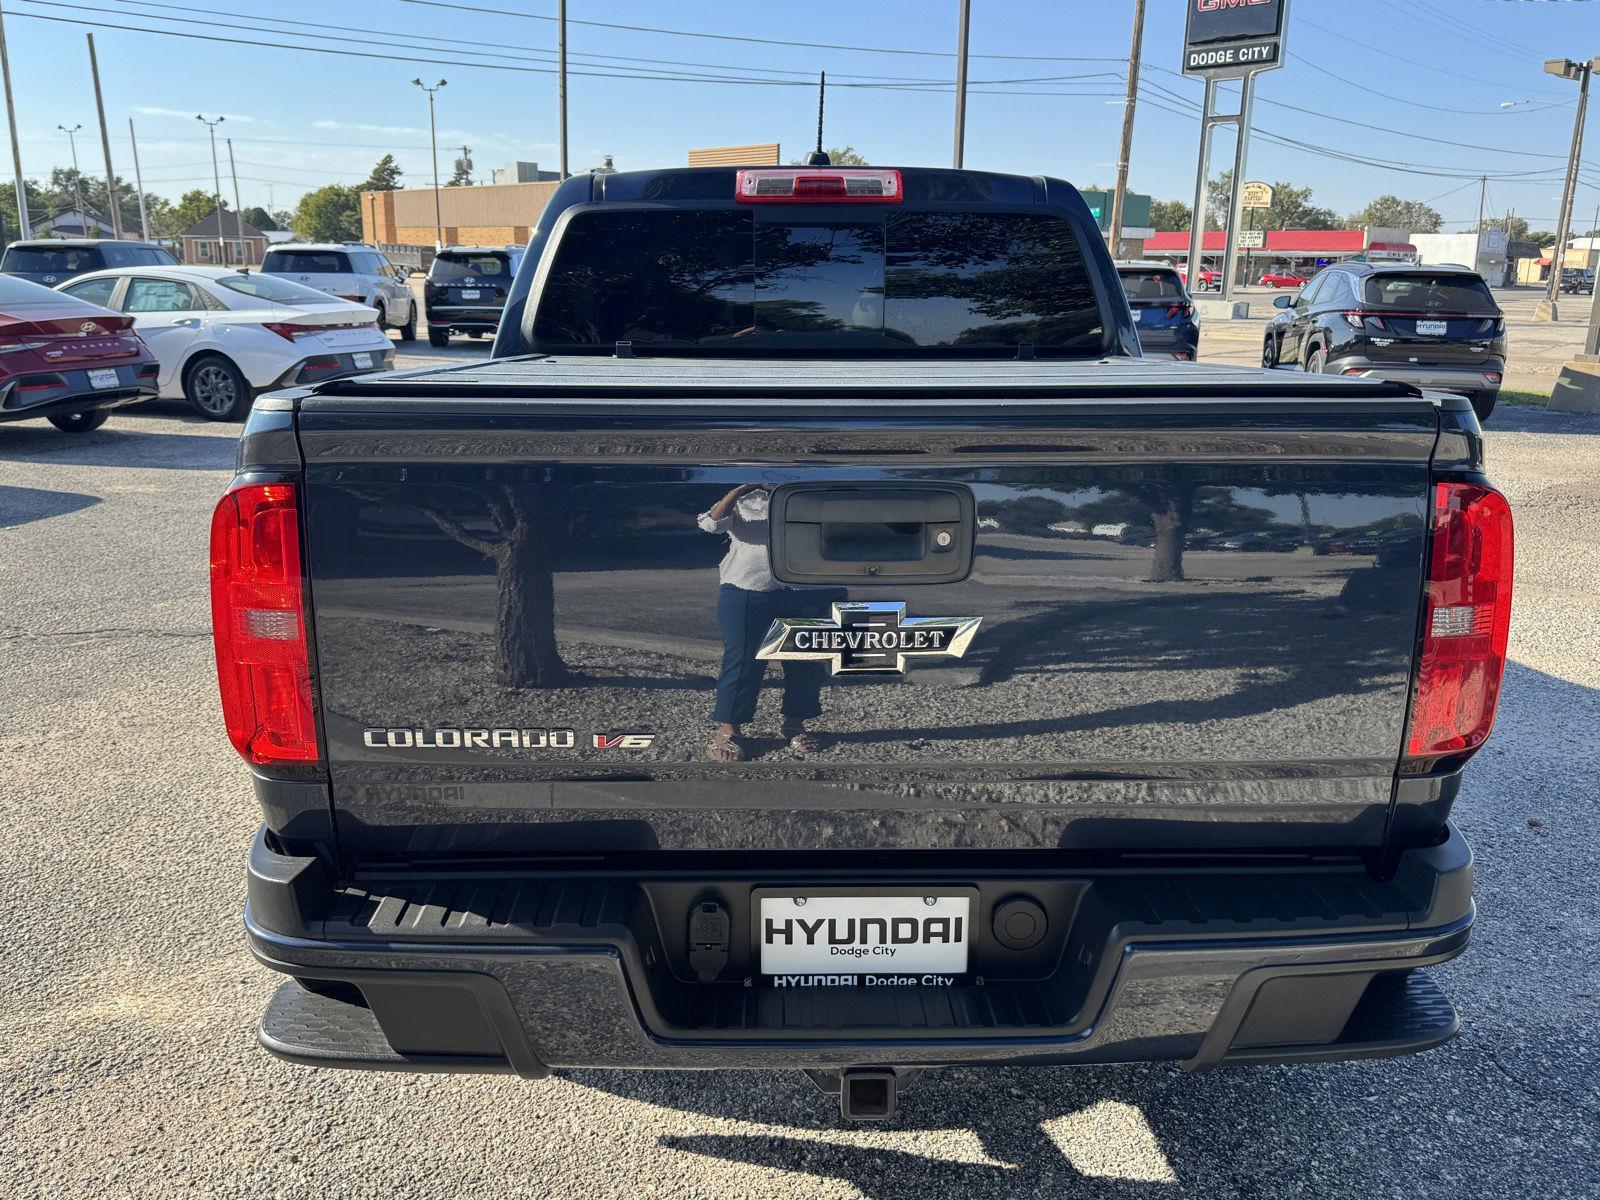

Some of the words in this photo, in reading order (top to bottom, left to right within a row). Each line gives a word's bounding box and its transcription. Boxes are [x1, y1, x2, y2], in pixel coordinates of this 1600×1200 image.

[1190, 50, 1234, 66] DODGE
[1239, 46, 1270, 61] CITY
[795, 631, 945, 649] CHEVROLET
[363, 728, 575, 748] COLORADO
[593, 734, 656, 749] V6
[765, 917, 963, 945] HYUNDAI
[830, 946, 870, 958] Dodge
[872, 946, 897, 957] City
[774, 975, 858, 987] HYUNDAI
[865, 975, 918, 986] Dodge
[921, 975, 954, 986] City
